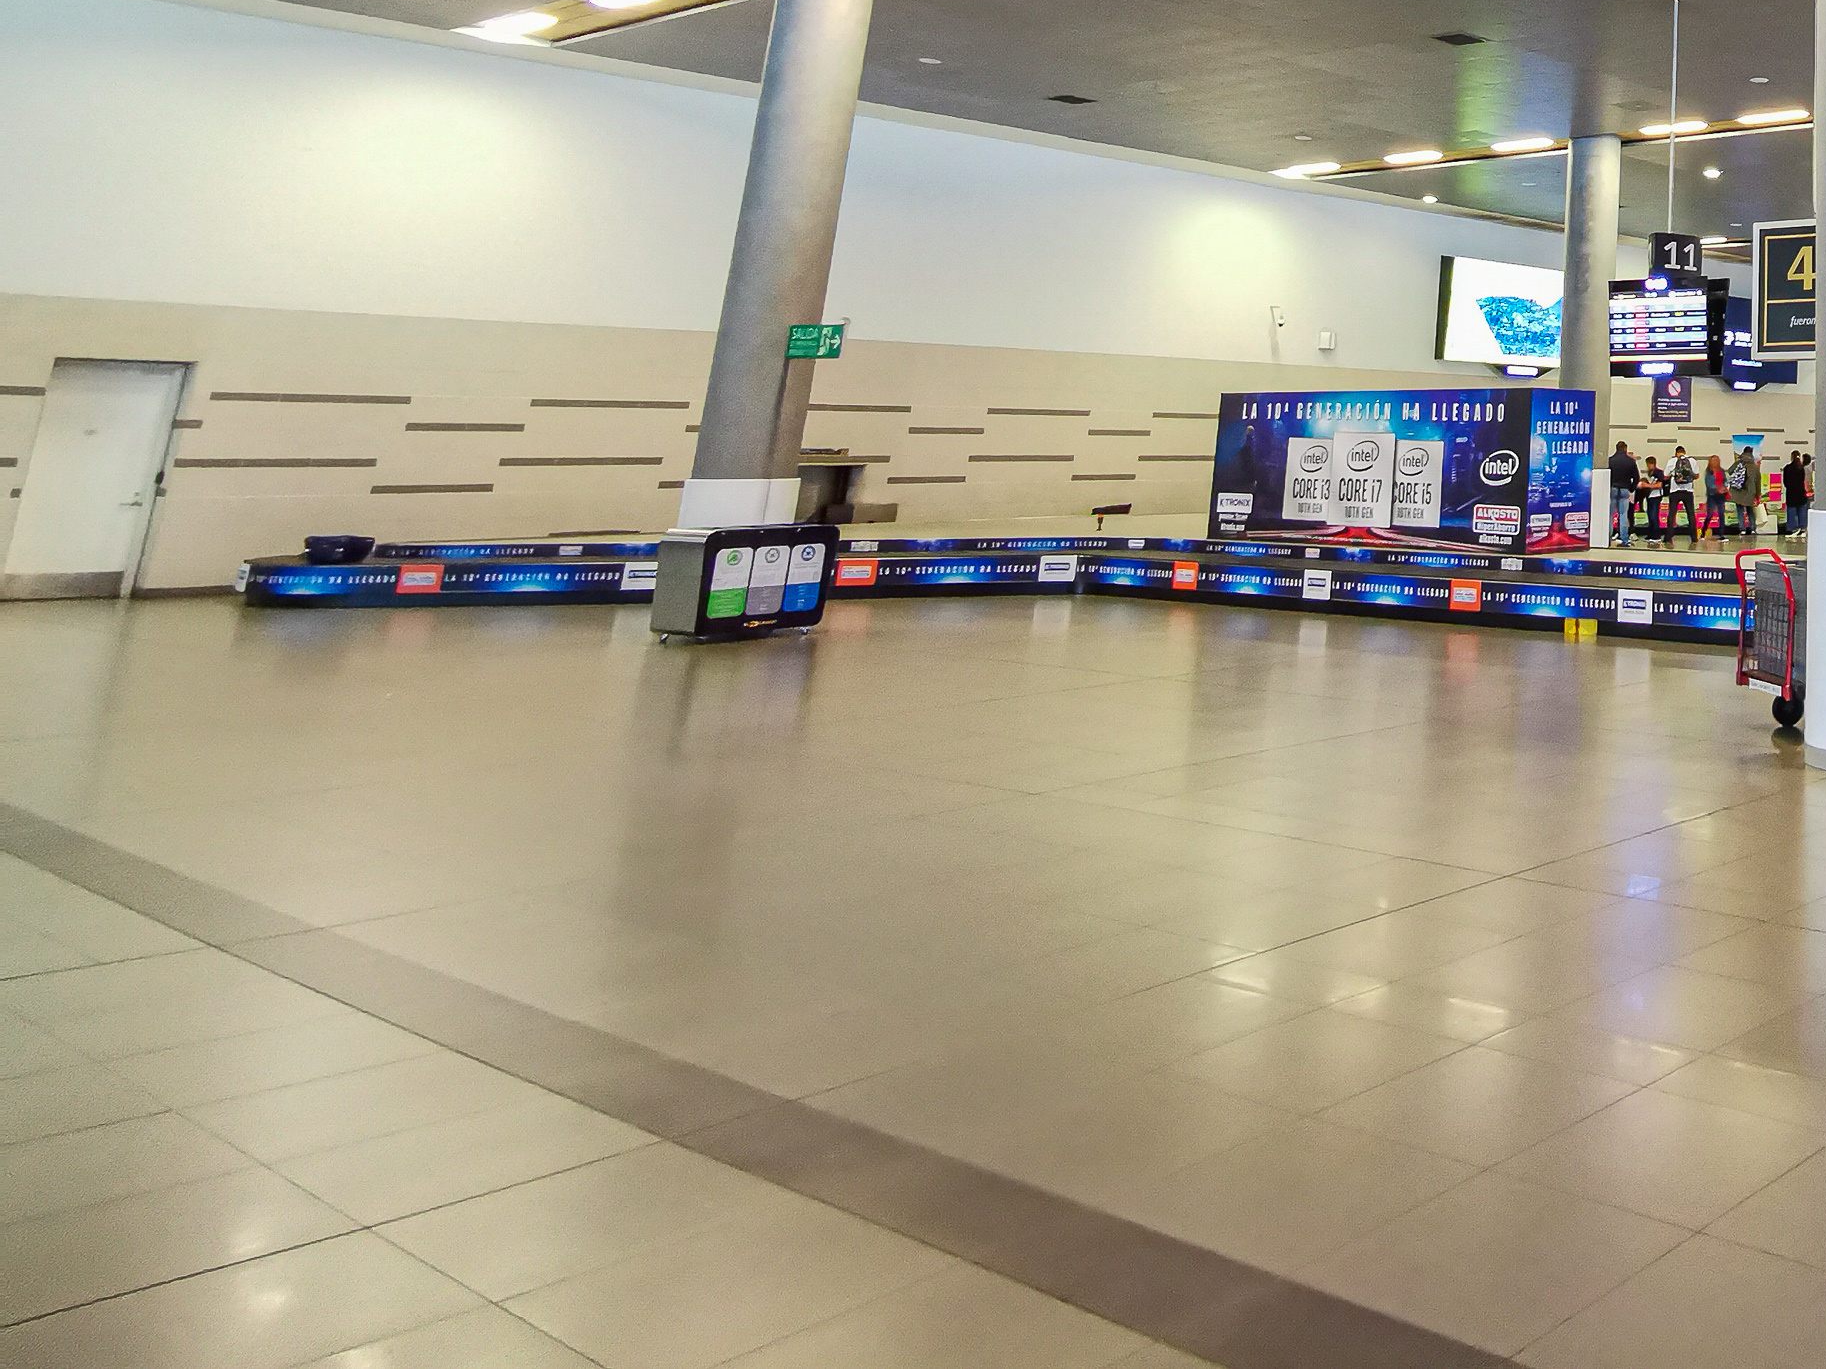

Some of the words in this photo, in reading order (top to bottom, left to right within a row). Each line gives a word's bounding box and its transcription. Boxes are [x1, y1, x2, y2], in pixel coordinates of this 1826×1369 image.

[1664, 241, 1698, 271] 11
[791, 328, 818, 339] SALIDA
[1242, 402, 1257, 420] LA
[1297, 400, 1391, 421] GENERACIÓN
[1402, 402, 1420, 421] HA
[1432, 402, 1505, 422] LLEGADO
[1550, 401, 1560, 415] LA
[1536, 419, 1591, 435] GENERACIÓN
[1351, 448, 1376, 462] intel
[1552, 441, 1589, 454] LLEGADO
[1304, 453, 1324, 465] intel
[1403, 454, 1425, 467] intel
[1485, 458, 1515, 475] intel
[1293, 478, 1318, 499] CORE
[1320, 477, 1331, 500] i3
[1338, 478, 1368, 503] CORE
[1371, 479, 1383, 503] i7
[1421, 482, 1432, 505] i5
[1477, 507, 1517, 520] ALKOSTO
